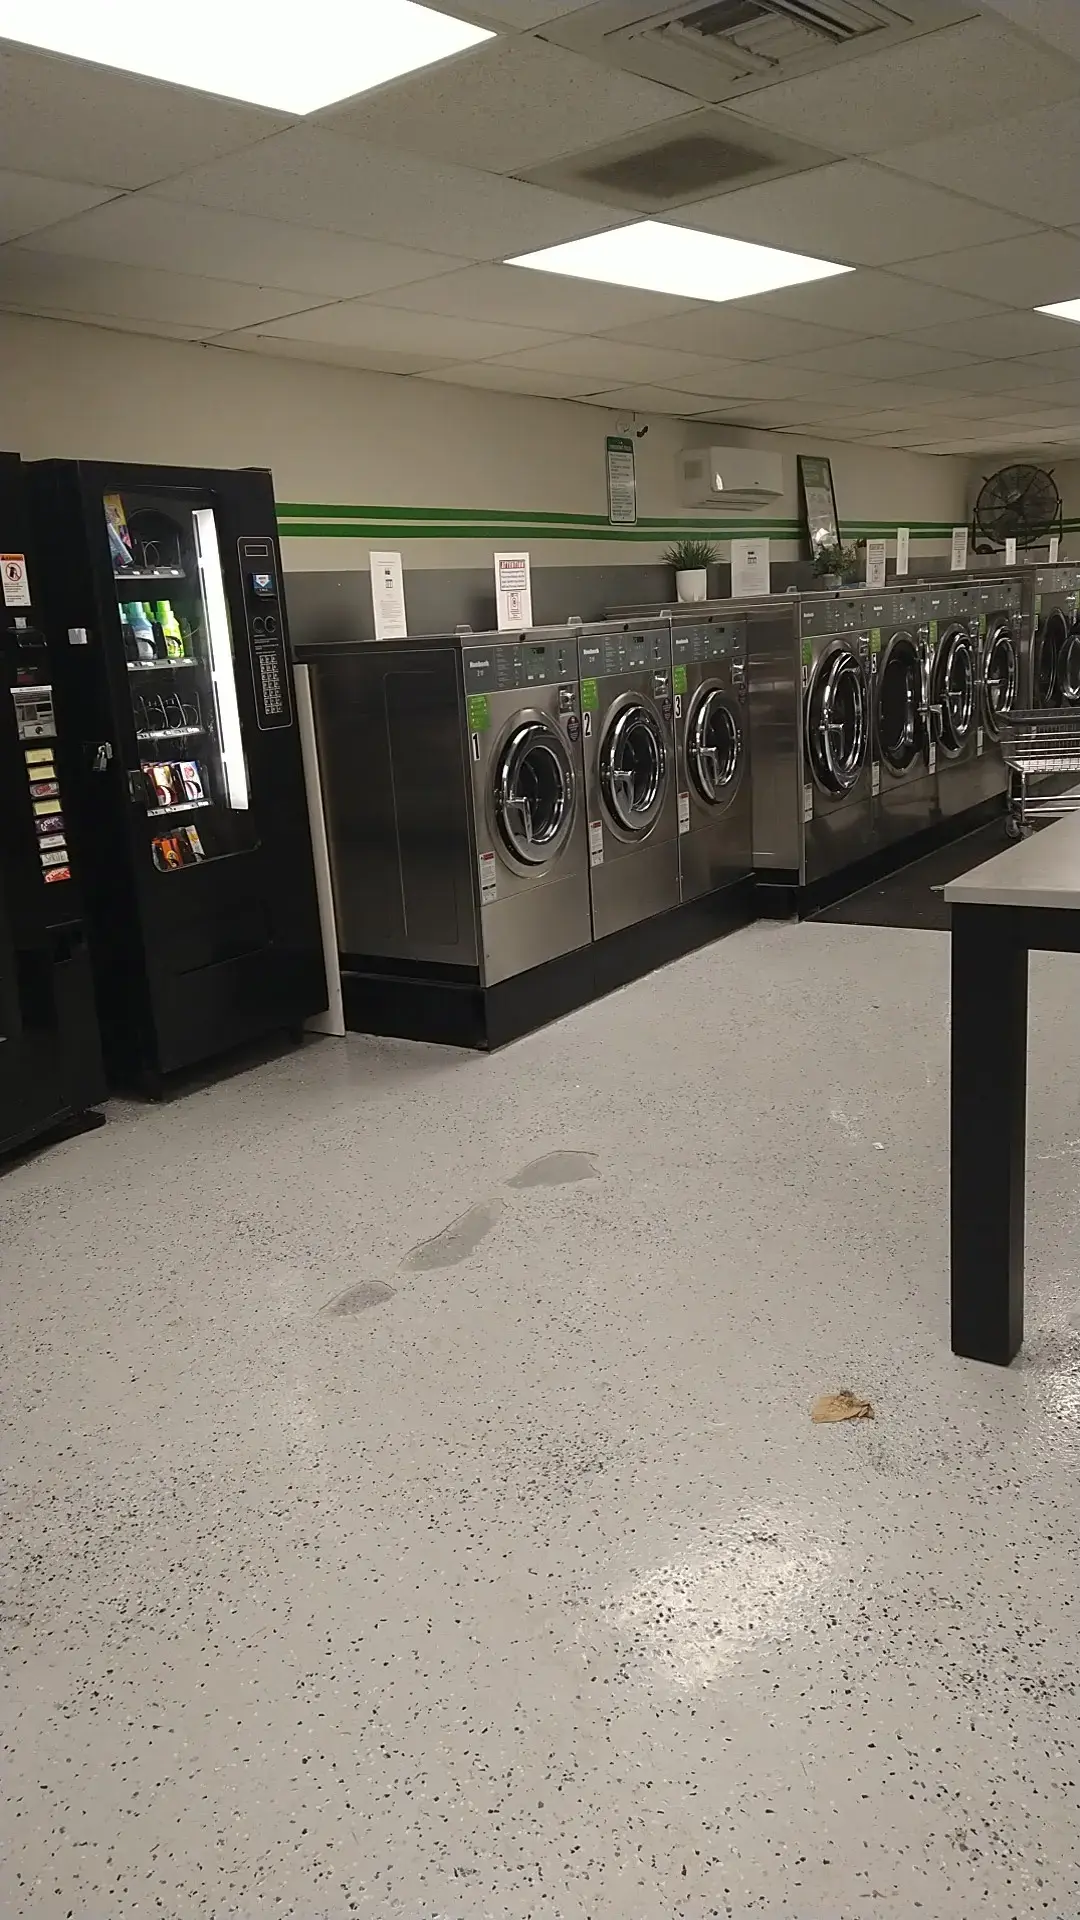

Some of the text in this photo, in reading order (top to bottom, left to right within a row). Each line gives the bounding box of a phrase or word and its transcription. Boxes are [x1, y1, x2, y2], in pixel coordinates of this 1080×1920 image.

[675, 696, 681, 717] 3
[584, 712, 591, 736] 2
[472, 733, 480, 759] 1
